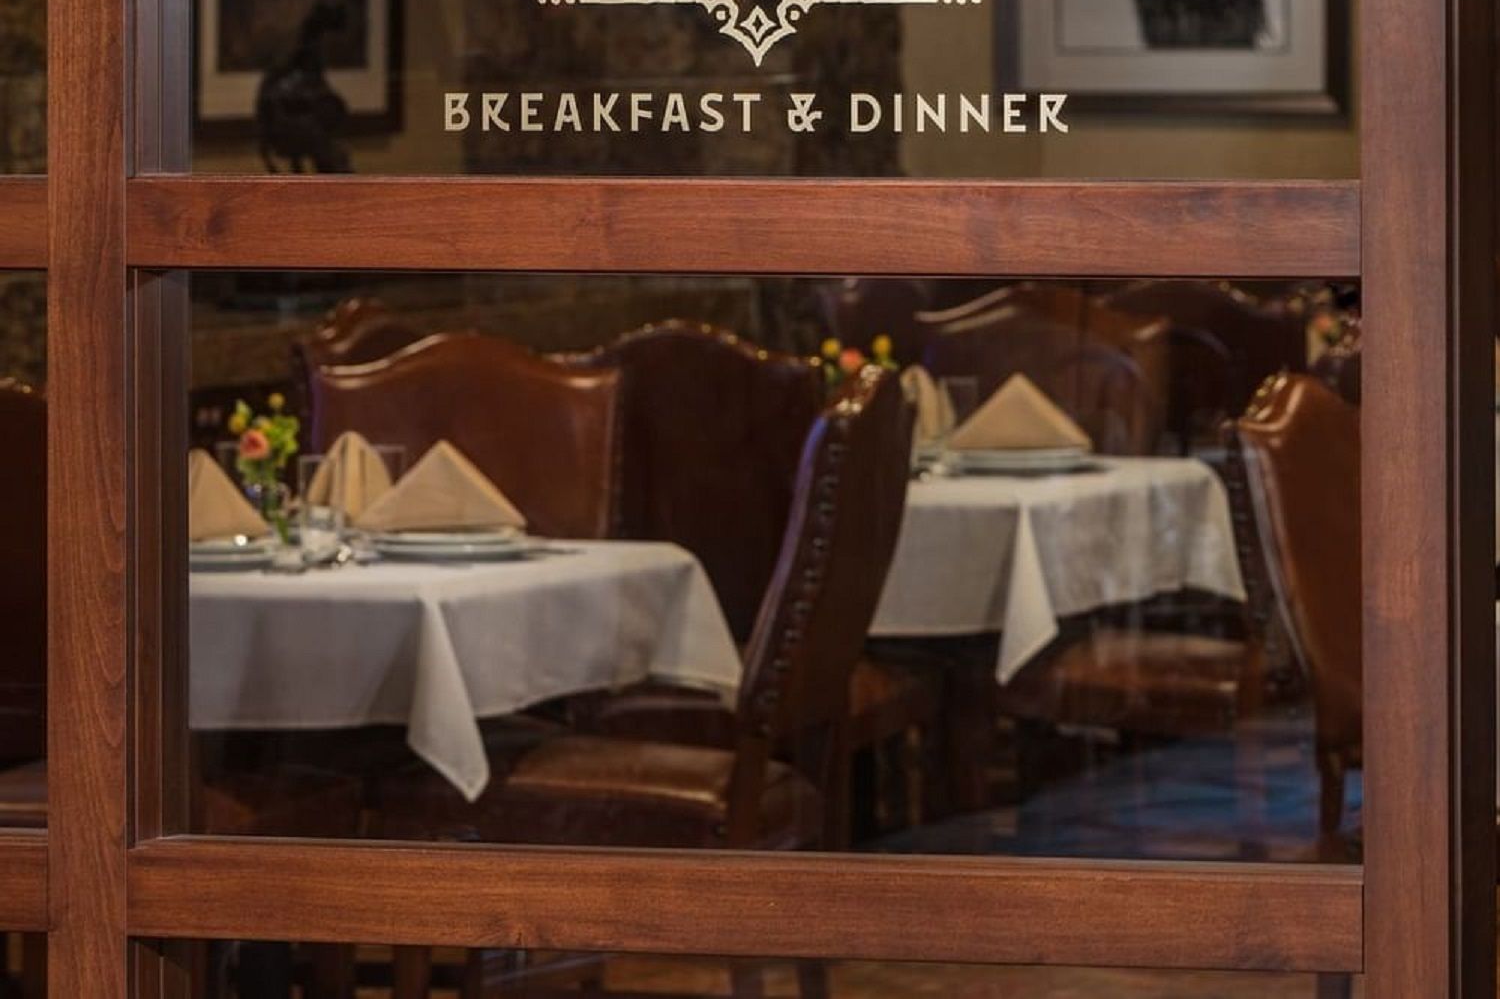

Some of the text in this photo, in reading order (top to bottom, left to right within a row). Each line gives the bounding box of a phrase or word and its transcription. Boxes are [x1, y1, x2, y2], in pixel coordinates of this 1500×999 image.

[445, 92, 1069, 133] BREAKFAST & DINNER
